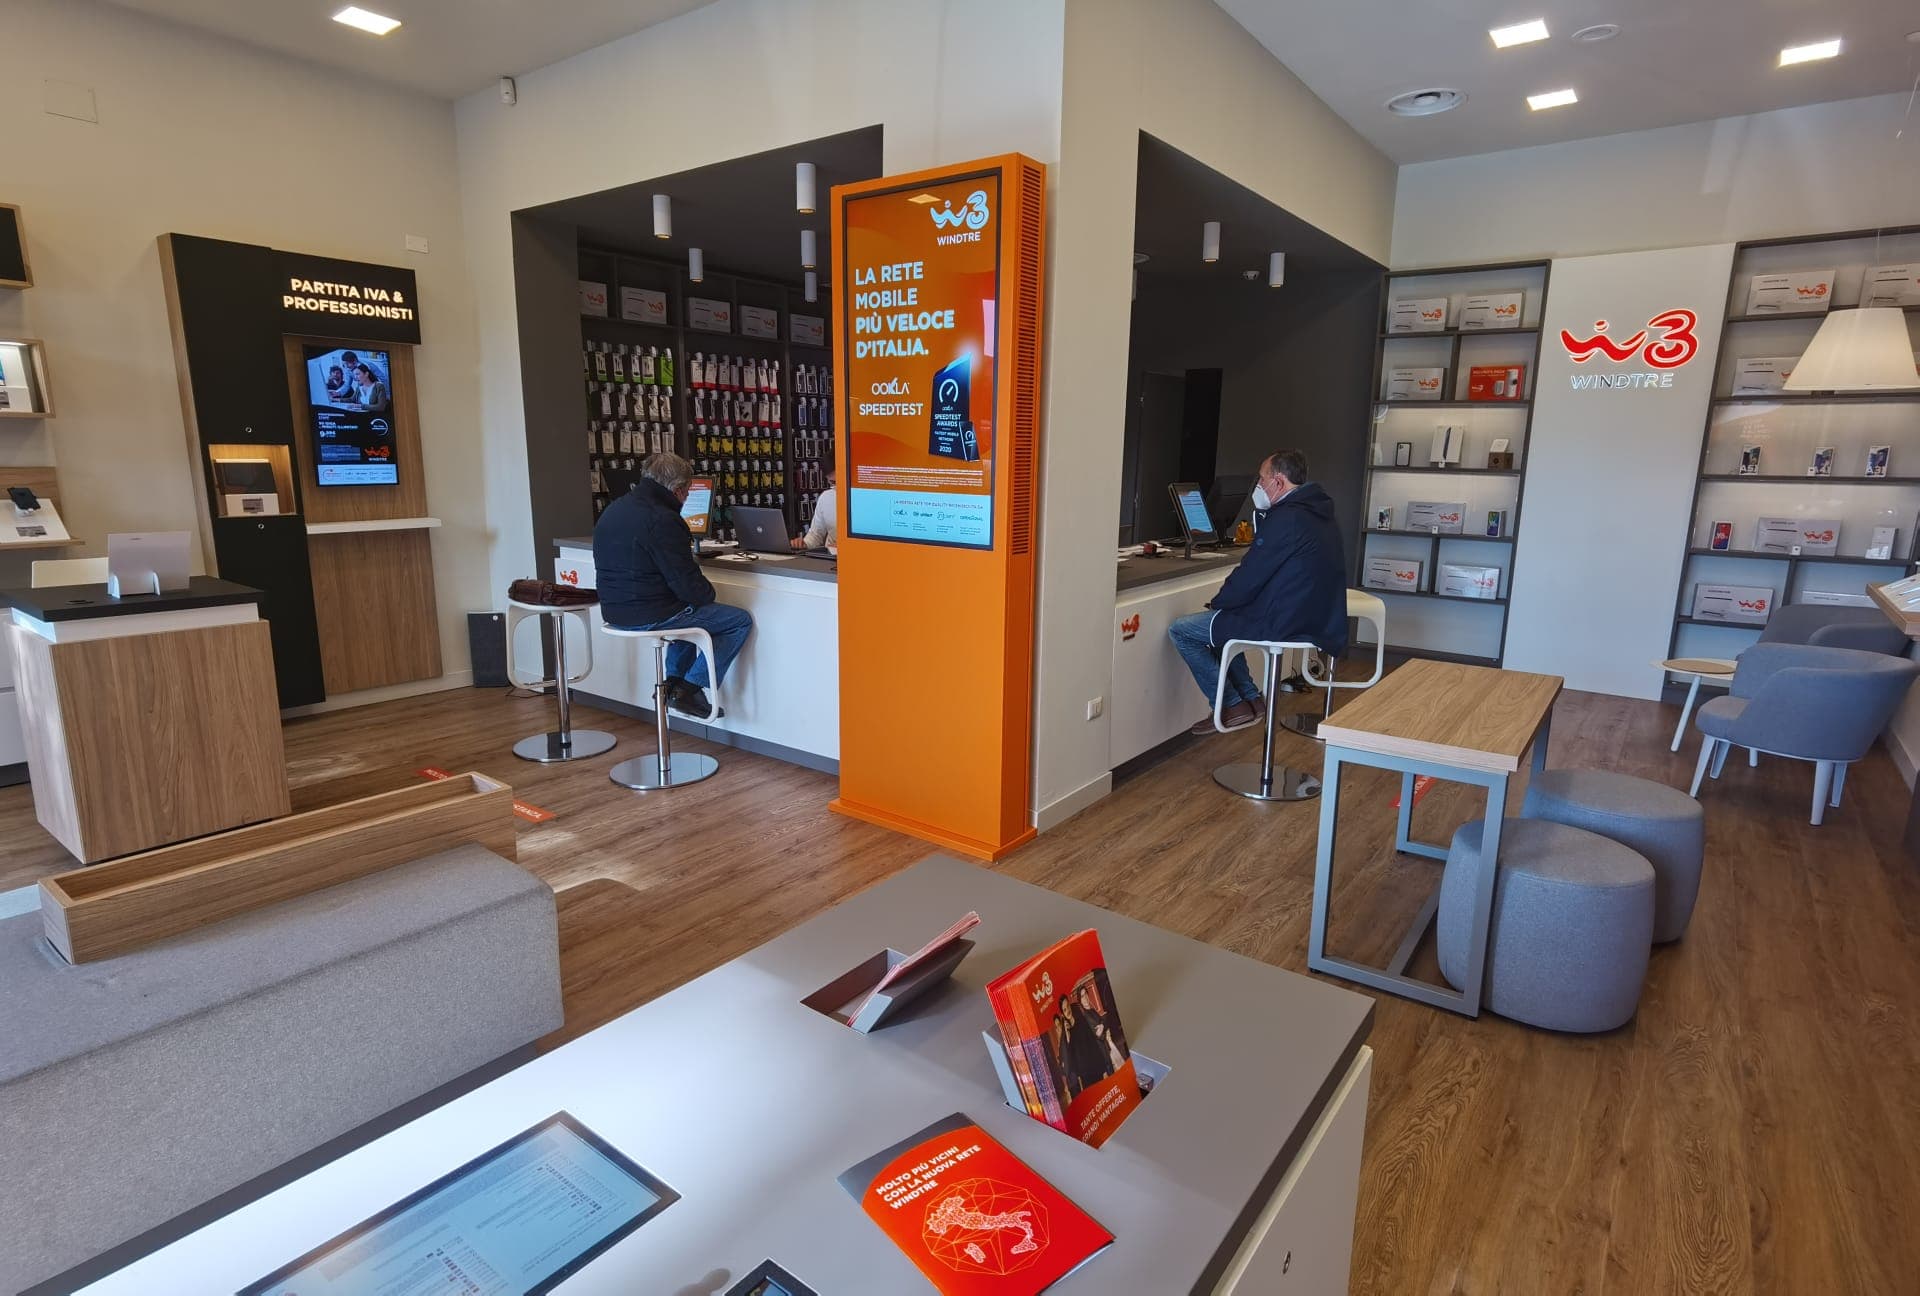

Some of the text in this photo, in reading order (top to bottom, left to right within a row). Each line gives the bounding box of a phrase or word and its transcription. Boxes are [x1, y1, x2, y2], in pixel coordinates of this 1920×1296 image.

[936, 231, 982, 246] WINDTRE
[855, 261, 924, 286] LA RETE
[290, 278, 404, 303] PARTITA IVA &
[855, 287, 918, 310] MOBILE
[283, 295, 413, 321] PROFESSIONISTI
[855, 309, 955, 335] PIÙ VELOCE
[856, 338, 929, 359] D'ITALIA.
[871, 377, 910, 397] OOKLA
[1570, 373, 1674, 390] WINDTRE
[859, 402, 924, 417] SPEEDTEST
[1080, 1108, 1096, 1130] TANTE
[875, 1172, 911, 1195] MOLTO
[928, 1146, 960, 1165] VICINI
[883, 1144, 982, 1202] CON LA NUOVA RETE
[890, 1180, 939, 1209] WINDTRE
